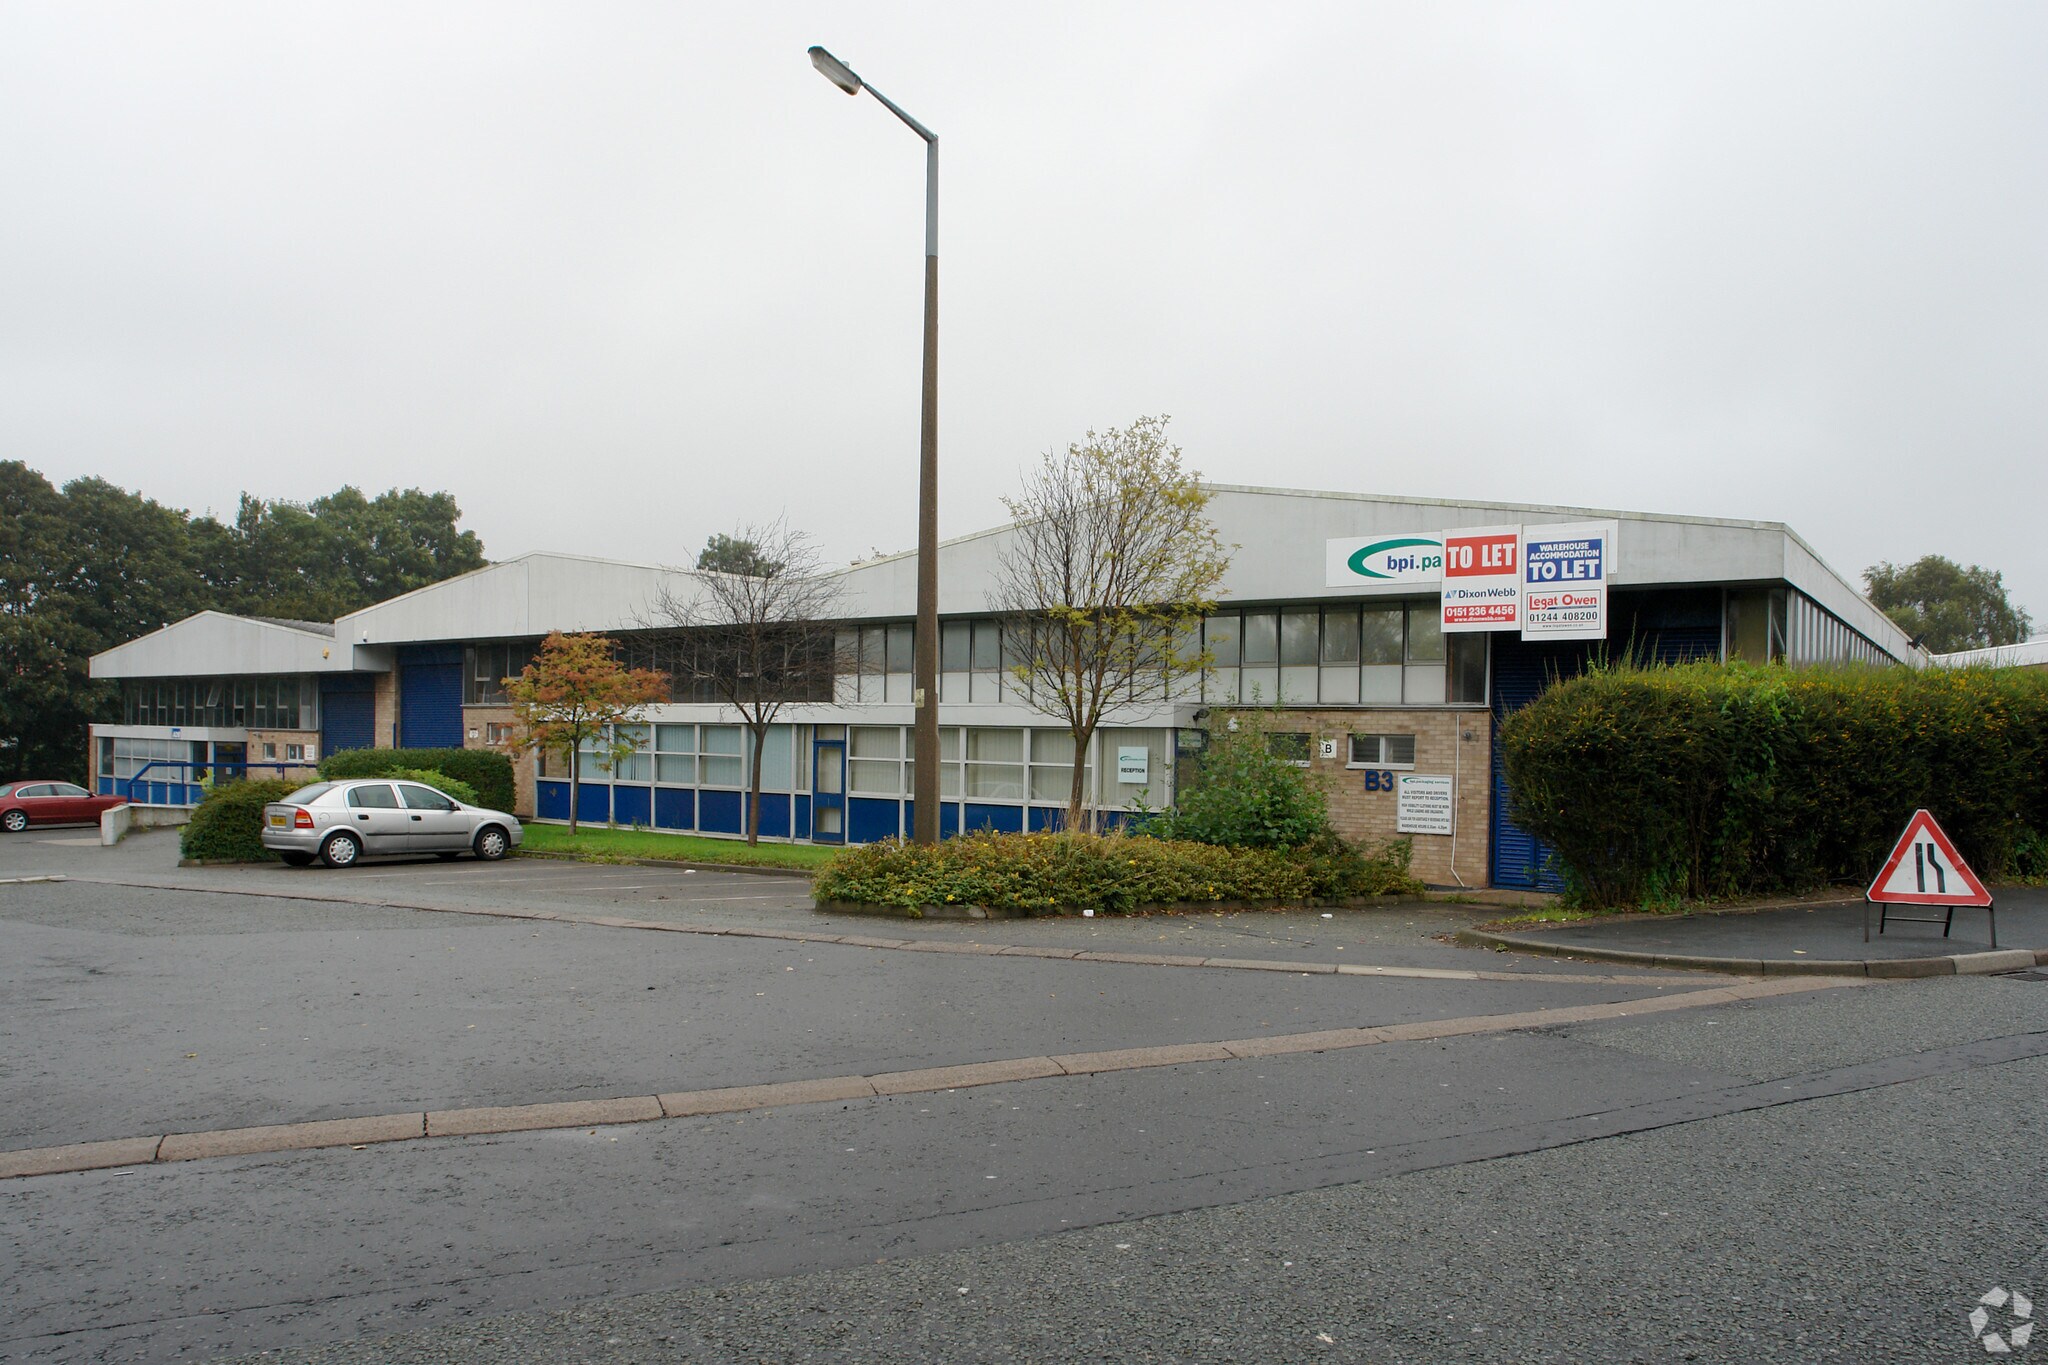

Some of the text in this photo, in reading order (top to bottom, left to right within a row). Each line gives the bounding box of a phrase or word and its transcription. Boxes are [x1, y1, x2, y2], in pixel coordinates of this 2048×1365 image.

[1539, 542, 1589, 552] WAREHOUSE
[1447, 543, 1515, 569] TO LET
[1529, 549, 1599, 560] ACCOMMODATION
[1529, 559, 1599, 580] TO LET
[1529, 594, 1597, 610] Legat Owen
[1446, 605, 1514, 617] 0151 236 4456
[1529, 611, 1598, 622] 01244 408200
[1325, 744, 1332, 753] B
[1365, 770, 1394, 792] B3
